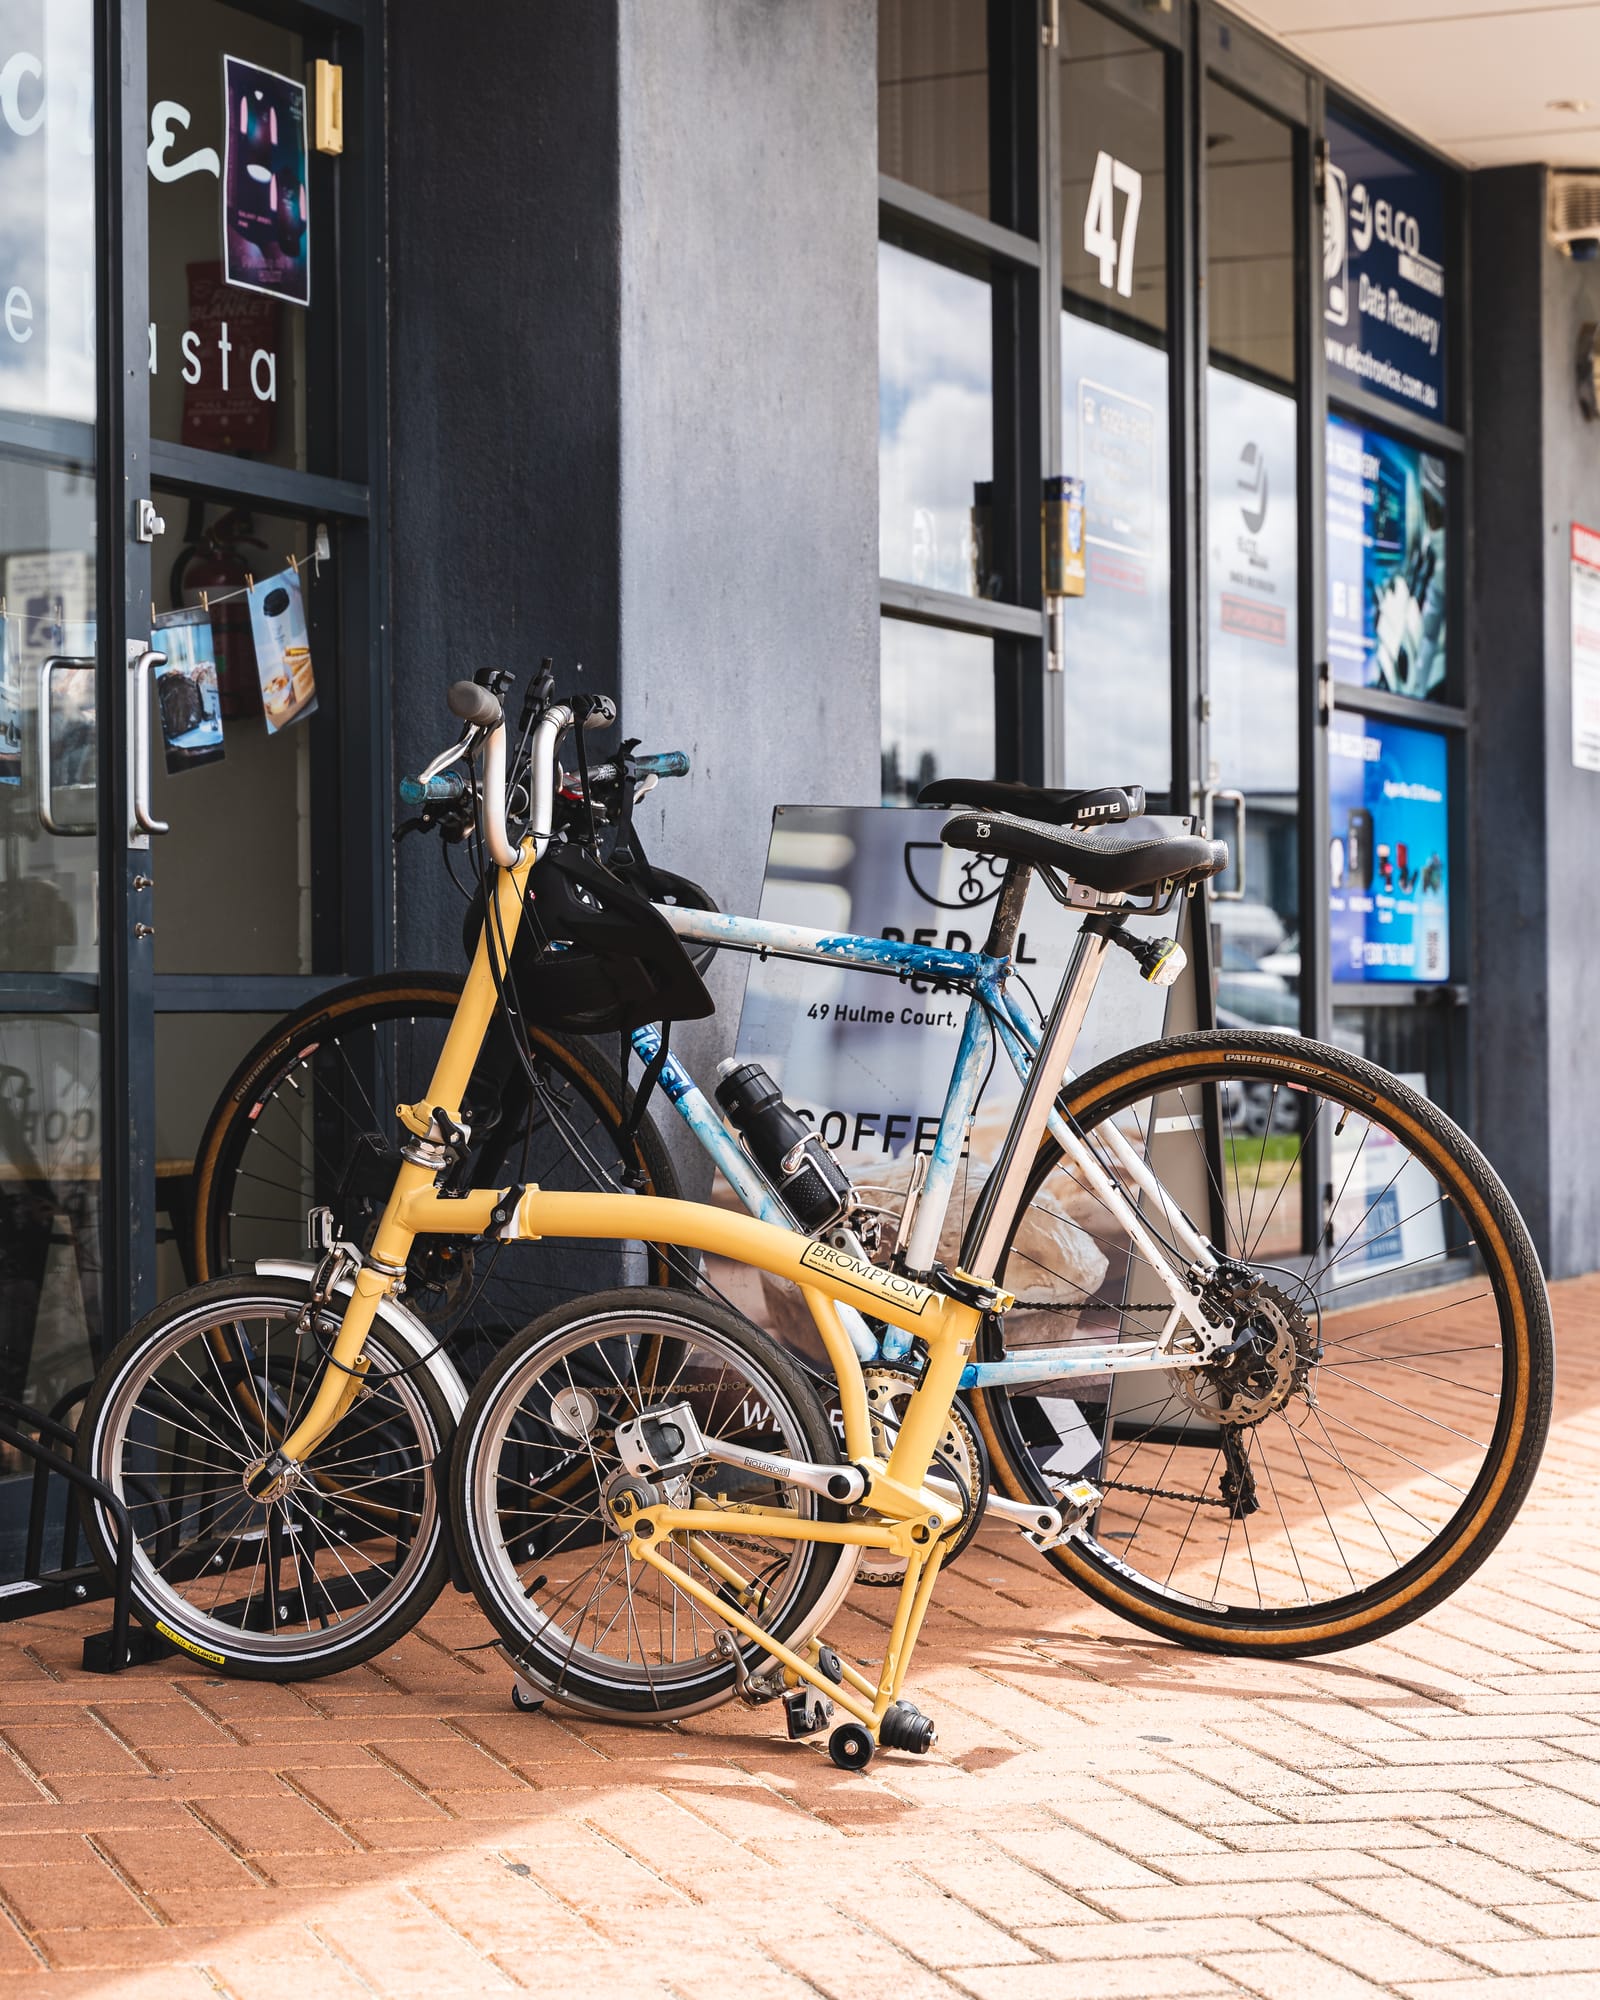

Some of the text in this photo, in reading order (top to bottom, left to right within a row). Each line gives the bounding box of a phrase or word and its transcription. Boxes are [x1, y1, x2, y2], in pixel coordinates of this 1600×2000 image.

[1083, 150, 1142, 298] 47
[1359, 272, 1387, 322] Data
[1387, 288, 1440, 356] Recovery
[1077, 802, 1121, 819] WTB
[807, 1003, 957, 1029] 49 Hulme Court,
[1225, 1053, 1301, 1070] PATHFINDER
[795, 1108, 970, 1158] OFFE
[811, 1245, 925, 1300] BROMPTON
[745, 1457, 789, 1476] BROMPTON
[188, 1644, 222, 1663] BROMPTON
